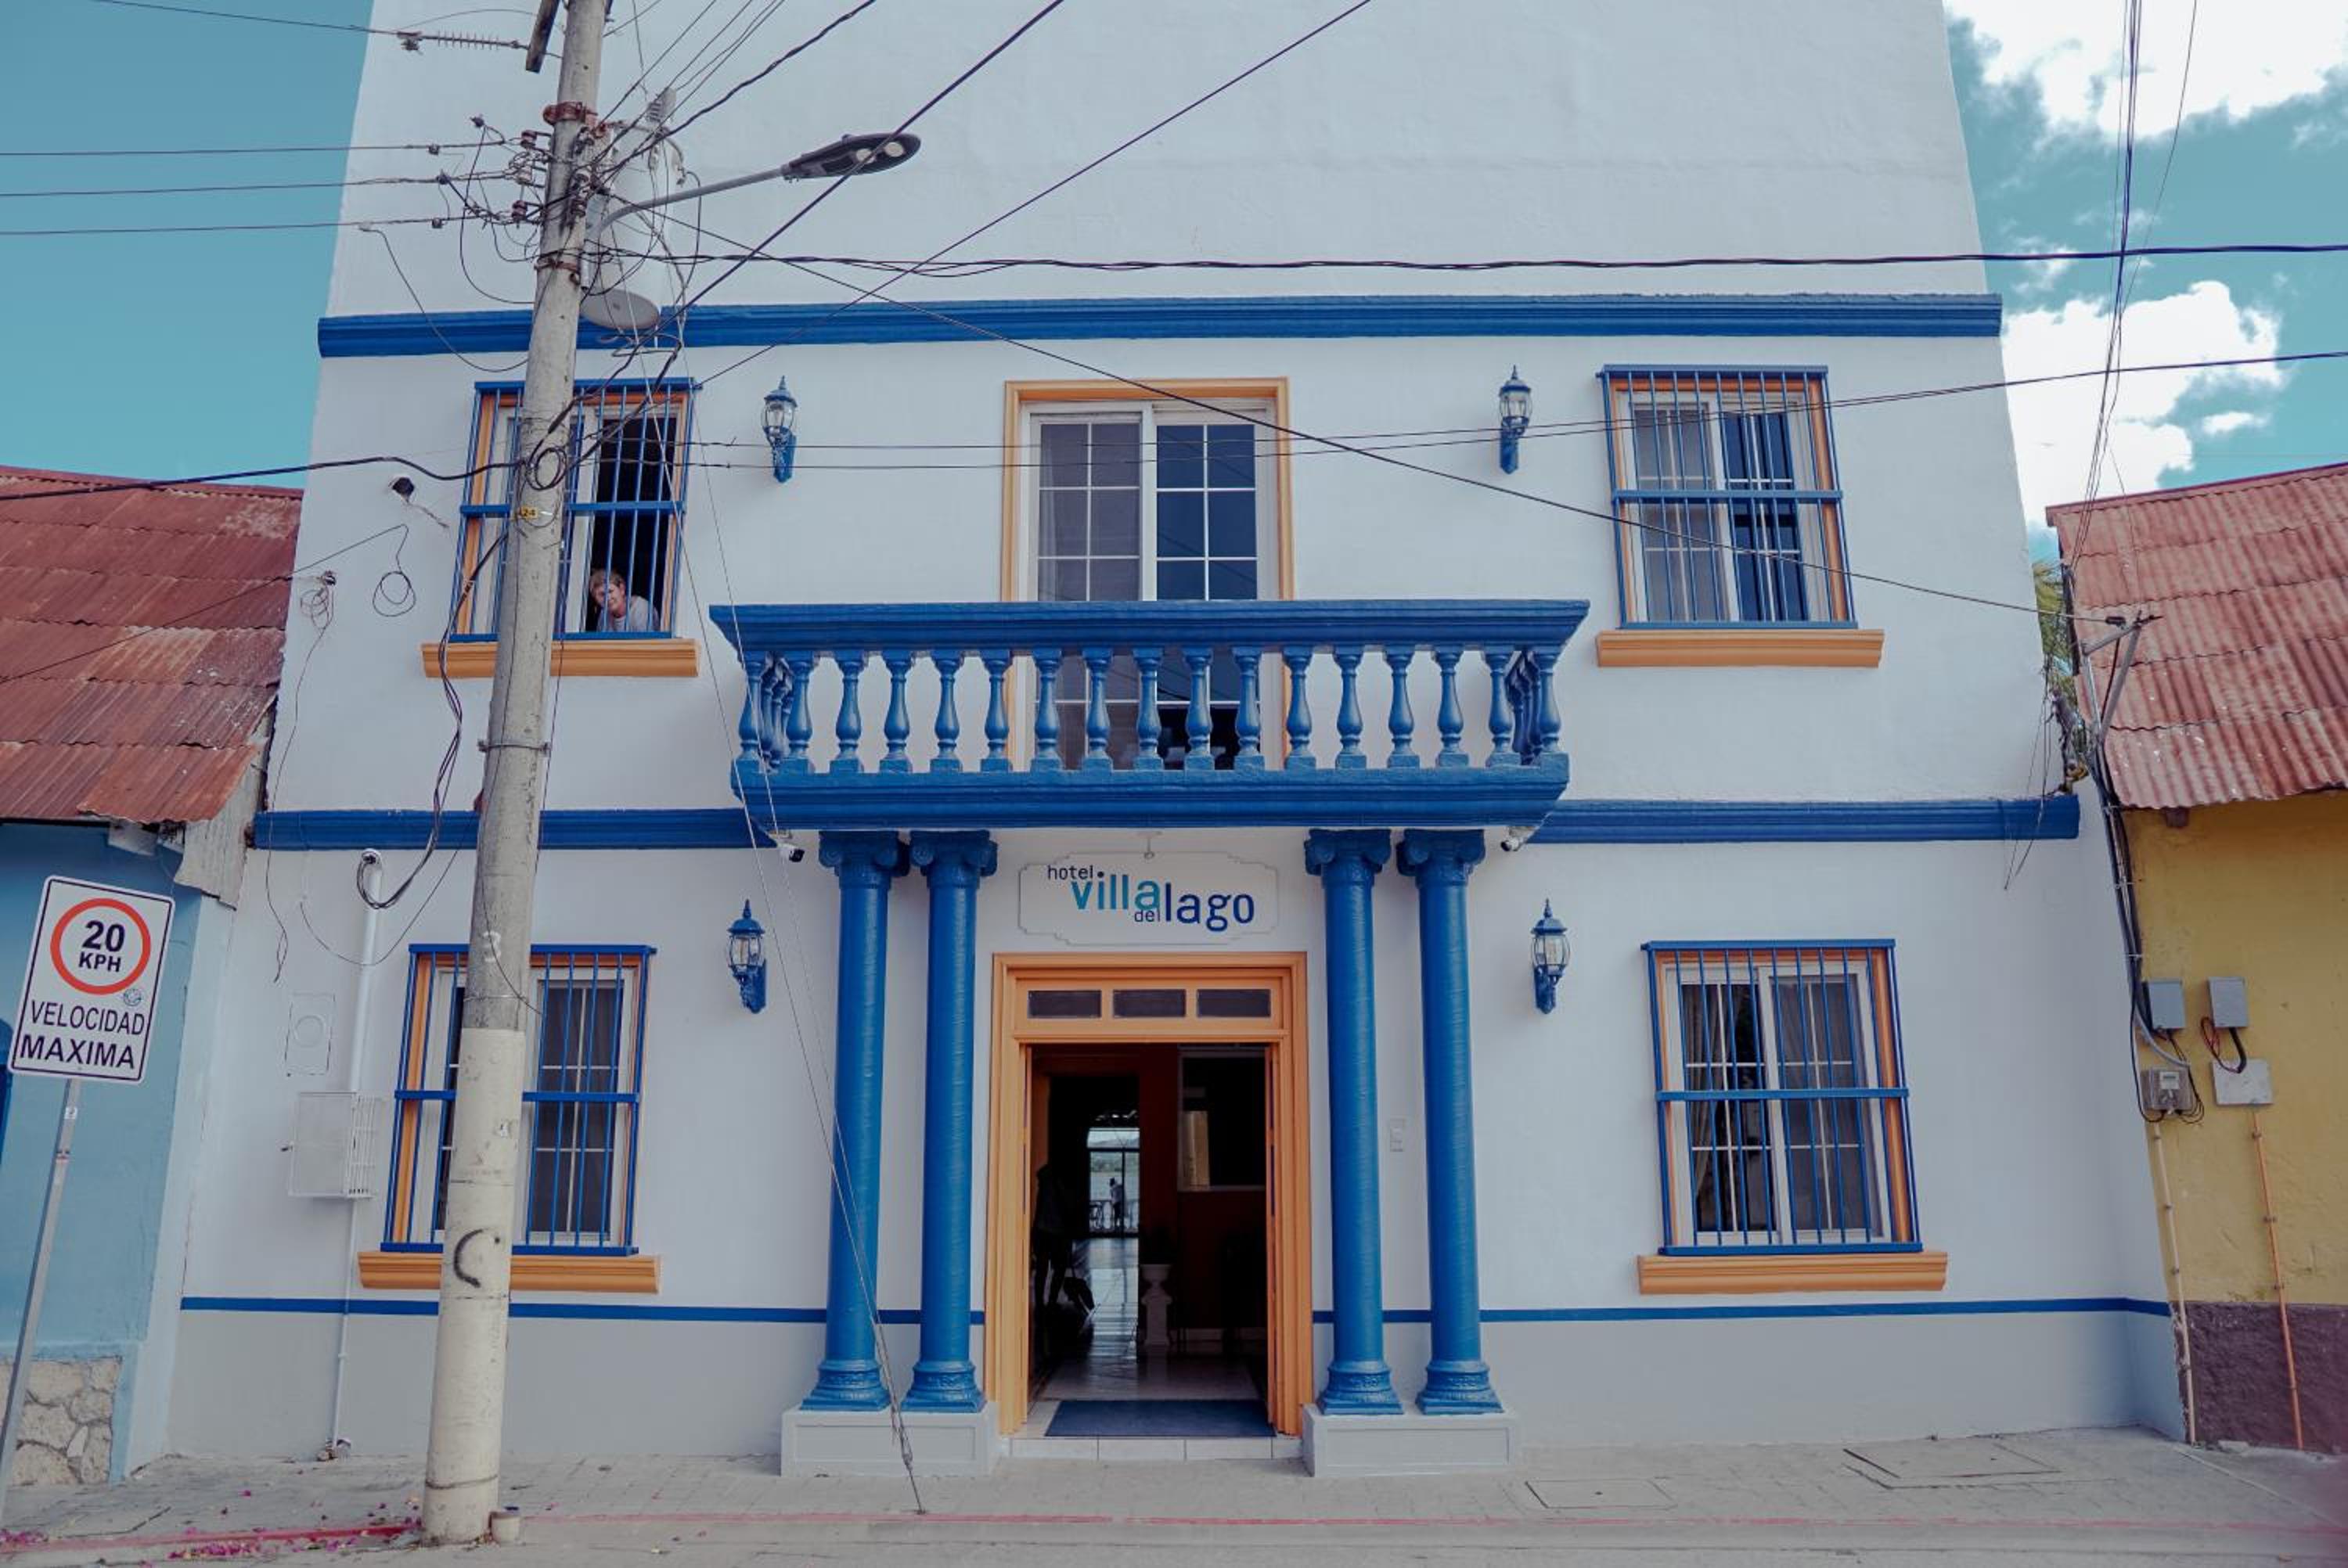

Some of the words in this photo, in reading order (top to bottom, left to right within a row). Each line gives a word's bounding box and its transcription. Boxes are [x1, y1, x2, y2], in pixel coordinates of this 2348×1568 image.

[1047, 865, 1093, 880] hotel
[1071, 871, 1160, 910] villa
[1165, 883, 1255, 932] lago
[1135, 910, 1161, 922] del
[82, 920, 125, 951] 20
[79, 952, 121, 972] KPH
[31, 1000, 145, 1035] VELOCIDAD
[20, 1034, 134, 1069] MAXIMA
